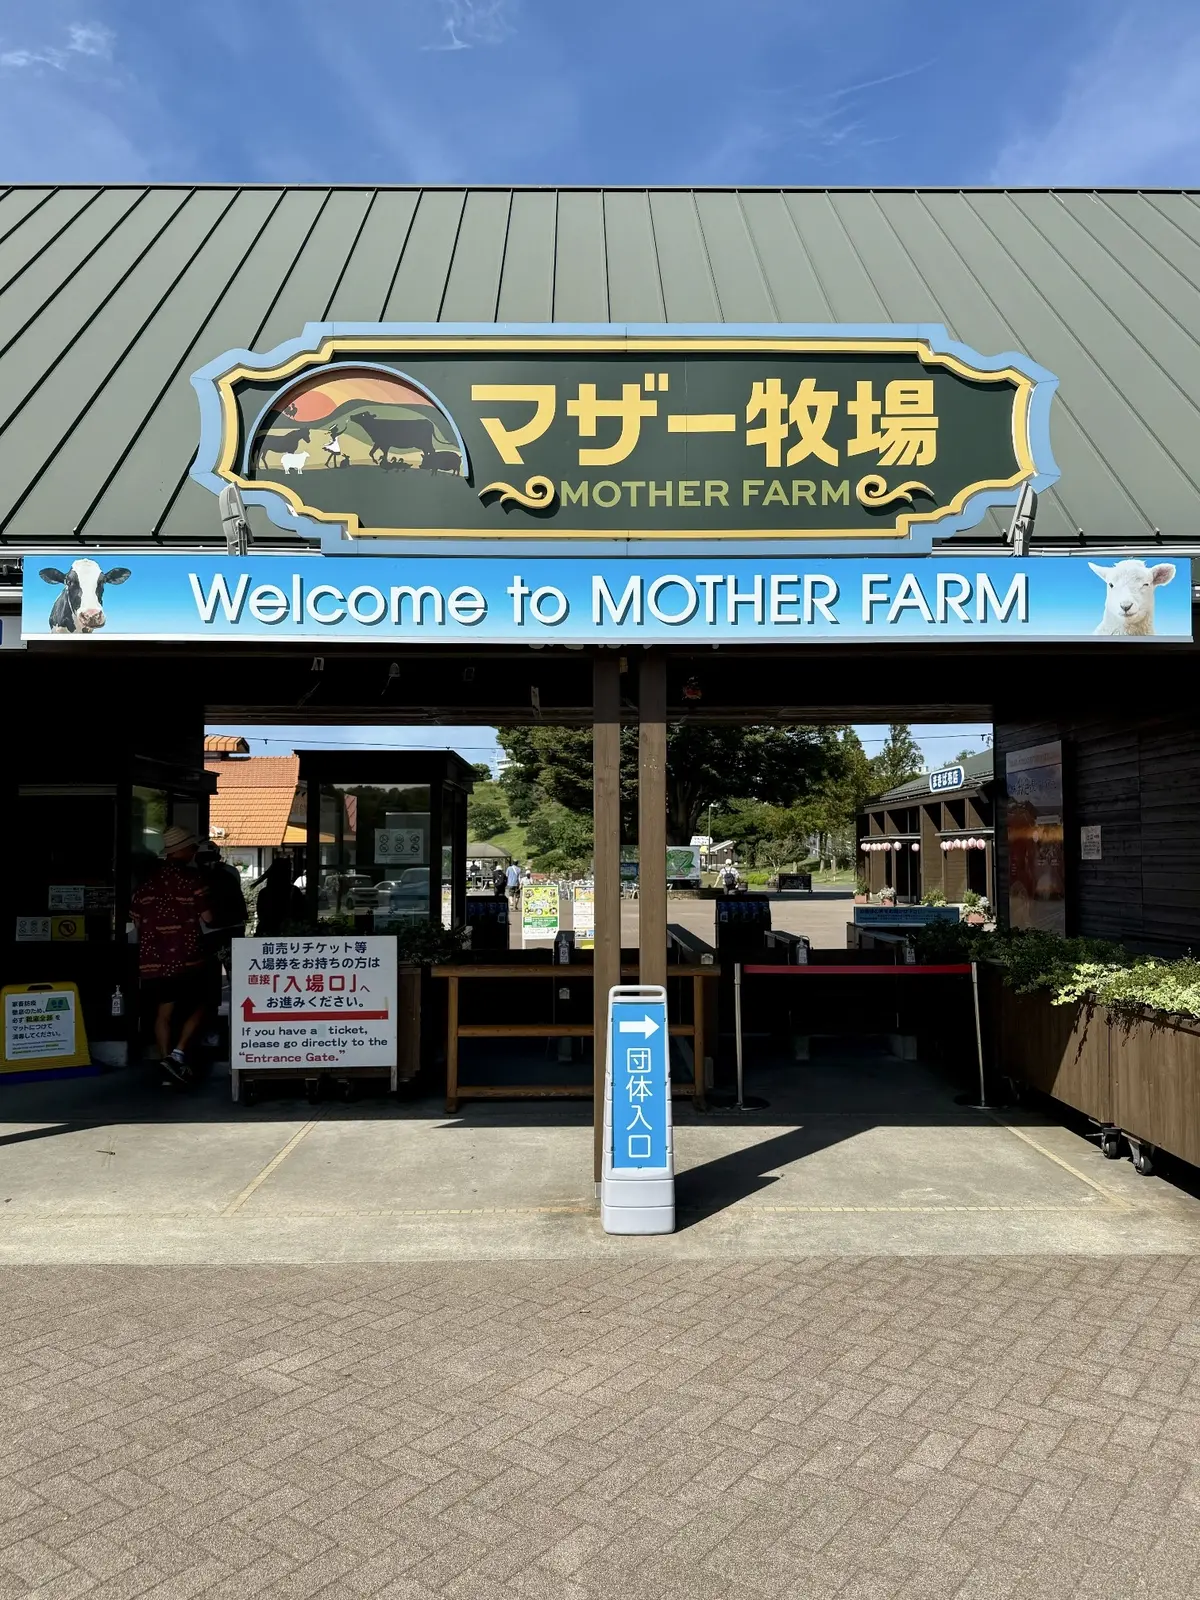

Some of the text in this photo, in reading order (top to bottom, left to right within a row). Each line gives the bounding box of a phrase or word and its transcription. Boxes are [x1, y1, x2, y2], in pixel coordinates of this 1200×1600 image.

[471, 373, 939, 467] マザー牧場
[560, 479, 850, 508] MOTHER FARM
[188, 572, 1029, 627] Welcome to MOTHER FARM
[261, 941, 367, 955] 前売りチケット等
[248, 957, 381, 971] 入場券をお持ちの方は
[266, 996, 365, 1009] お進みください。
[241, 1027, 251, 1036] If
[254, 1028, 276, 1037] you
[278, 1026, 307, 1036] have
[328, 1025, 368, 1036] ticket,
[240, 1037, 388, 1049] please go directly to the
[626, 1047, 653, 1158] 団体入口
